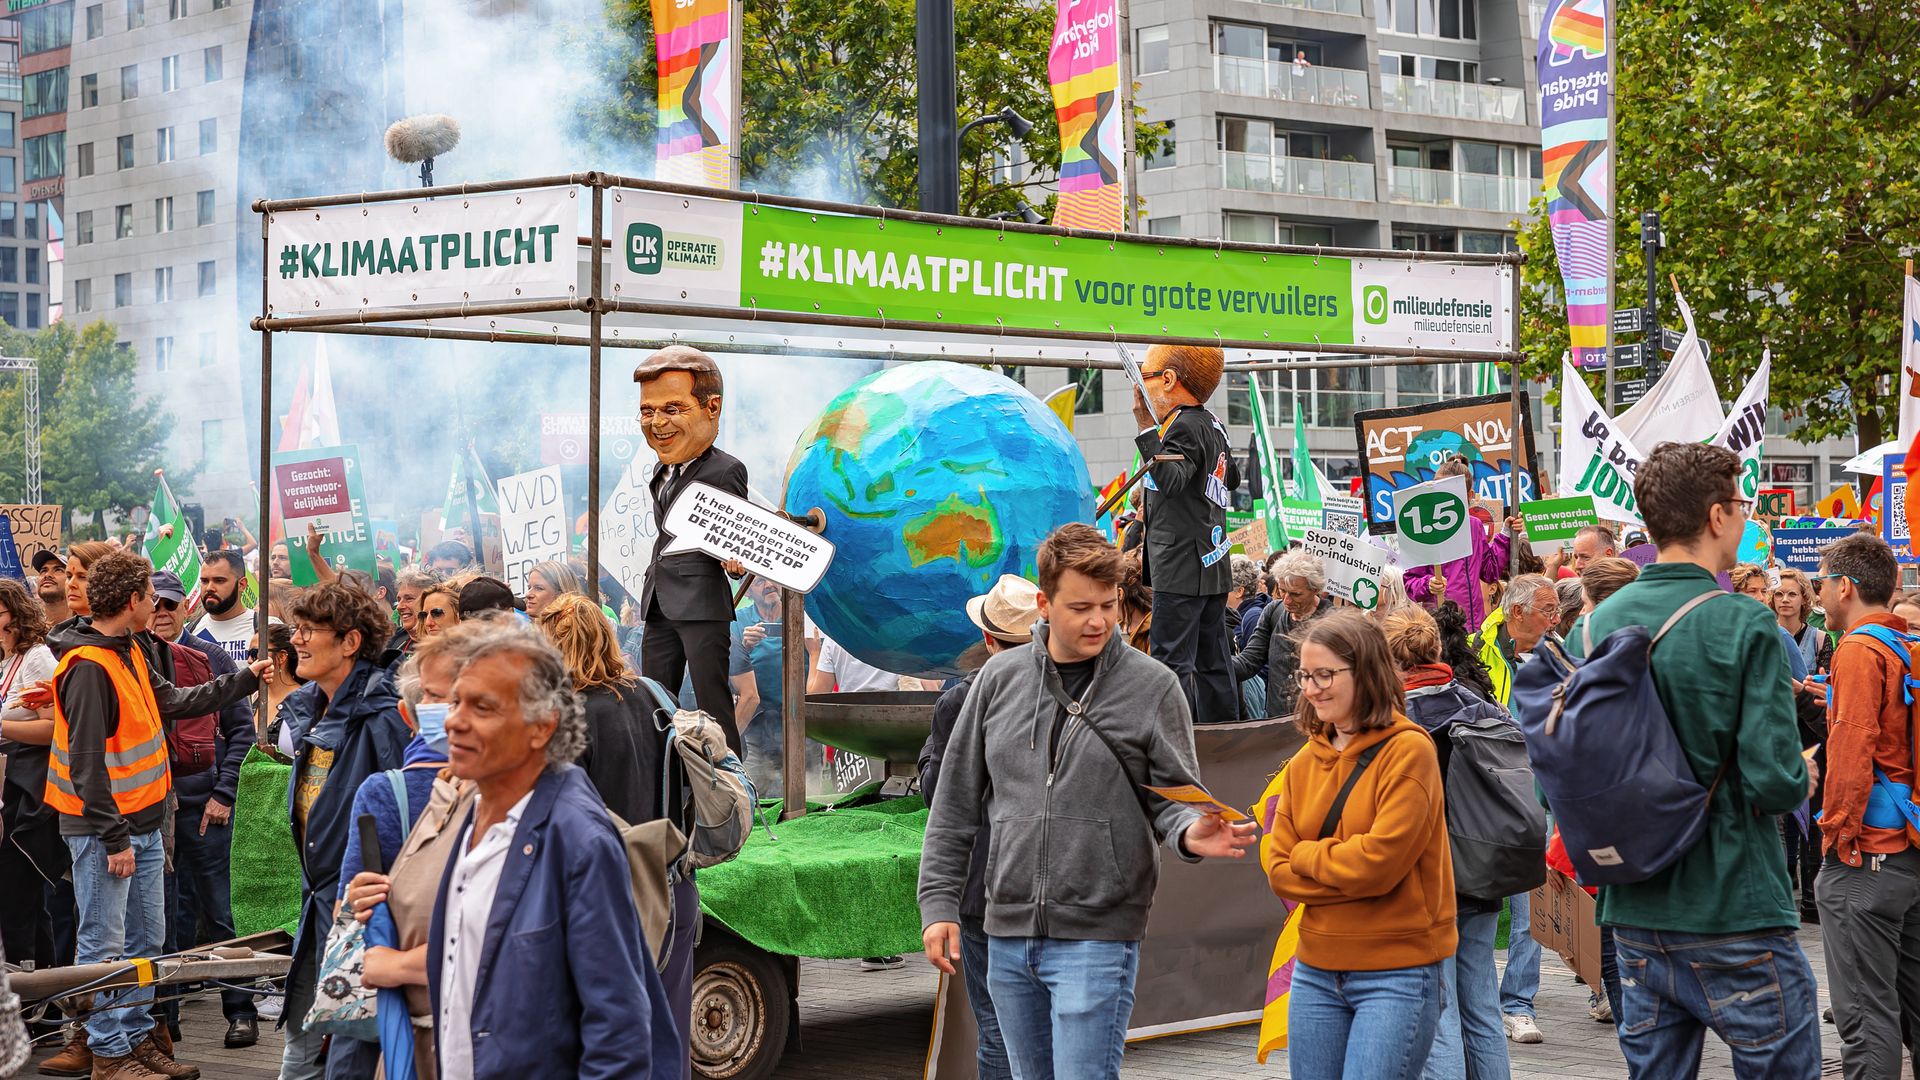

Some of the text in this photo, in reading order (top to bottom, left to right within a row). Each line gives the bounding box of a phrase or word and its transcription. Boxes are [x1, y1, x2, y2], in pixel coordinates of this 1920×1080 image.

[279, 224, 559, 280] #KLIMAATPLICHT
[667, 240, 716, 256] OPERATIE
[667, 252, 716, 266] KLIMAAT!
[759, 240, 1338, 317] #KLIMAATPLICHT voor grote vervuilers
[1393, 296, 1492, 318] milieudefensie
[1414, 318, 1493, 334] milieudefensie.nl
[1366, 426, 1423, 457] ACT
[1430, 448, 1453, 465] or
[291, 467, 331, 482] Gezocht:
[285, 482, 342, 497] verantwoor-
[502, 474, 557, 514] VVD
[1206, 475, 1228, 507] ING
[294, 494, 338, 511] delijkheid
[695, 491, 818, 553] Ik heb geen actieve
[1403, 499, 1459, 534] 1.5
[1525, 508, 1594, 522] Geen woorden
[1534, 518, 1590, 531] maar daden
[503, 515, 560, 555] WEG
[688, 513, 804, 570] DE KLIMAATTOP
[693, 503, 810, 562] herinneringen aan
[1306, 530, 1354, 551] Stop de
[1776, 537, 1814, 545] Gezonde
[703, 532, 774, 571] IN PARIJS.
[1304, 544, 1381, 577] bio-industrie!
[1792, 546, 1819, 554] hebbe
[1328, 578, 1340, 589] Partij
[1334, 587, 1350, 597] Dieren
[229, 640, 246, 651] THE
[837, 759, 866, 793] SHOP
